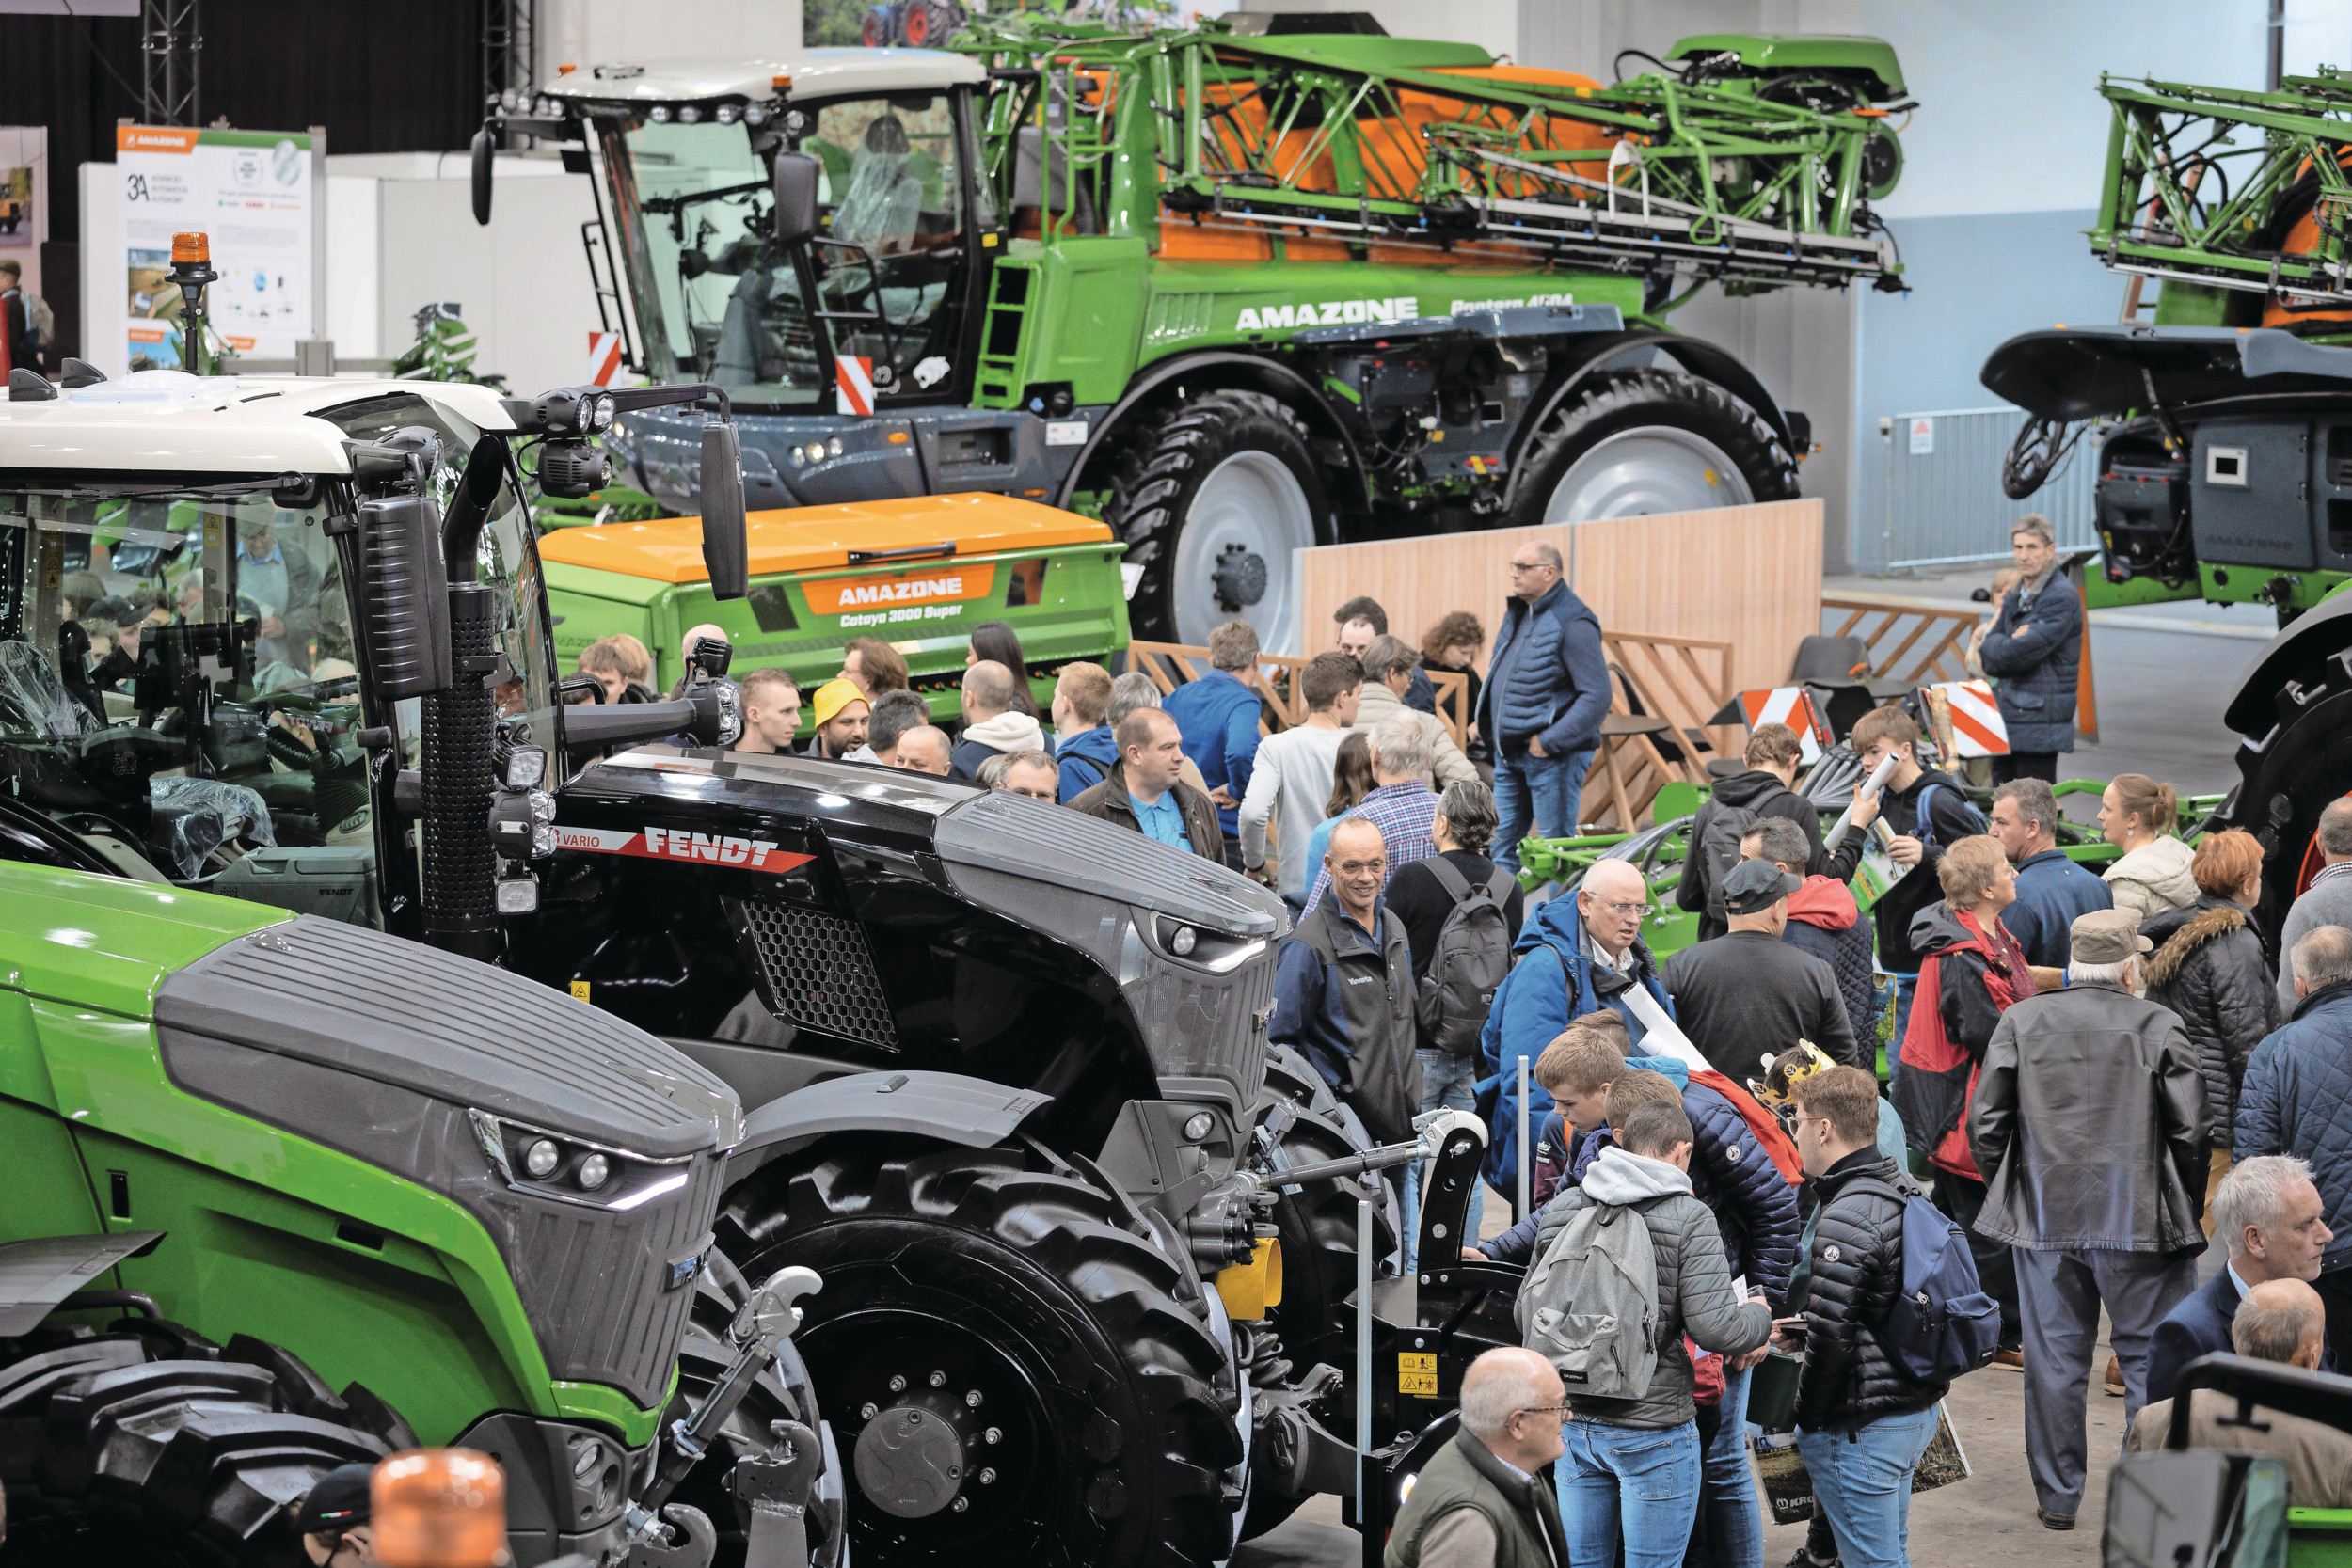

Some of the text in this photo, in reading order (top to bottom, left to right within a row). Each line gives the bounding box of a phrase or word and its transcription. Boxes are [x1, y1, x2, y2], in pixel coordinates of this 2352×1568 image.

[127, 174, 150, 201] 3A
[1235, 297, 1419, 331] AMAZONE
[839, 577, 963, 606] AMAZONE
[840, 605, 963, 627] Cataya 3000 Super
[563, 833, 600, 847] VARIO
[644, 826, 779, 866] FENDT
[319, 888, 354, 896] FENDT
